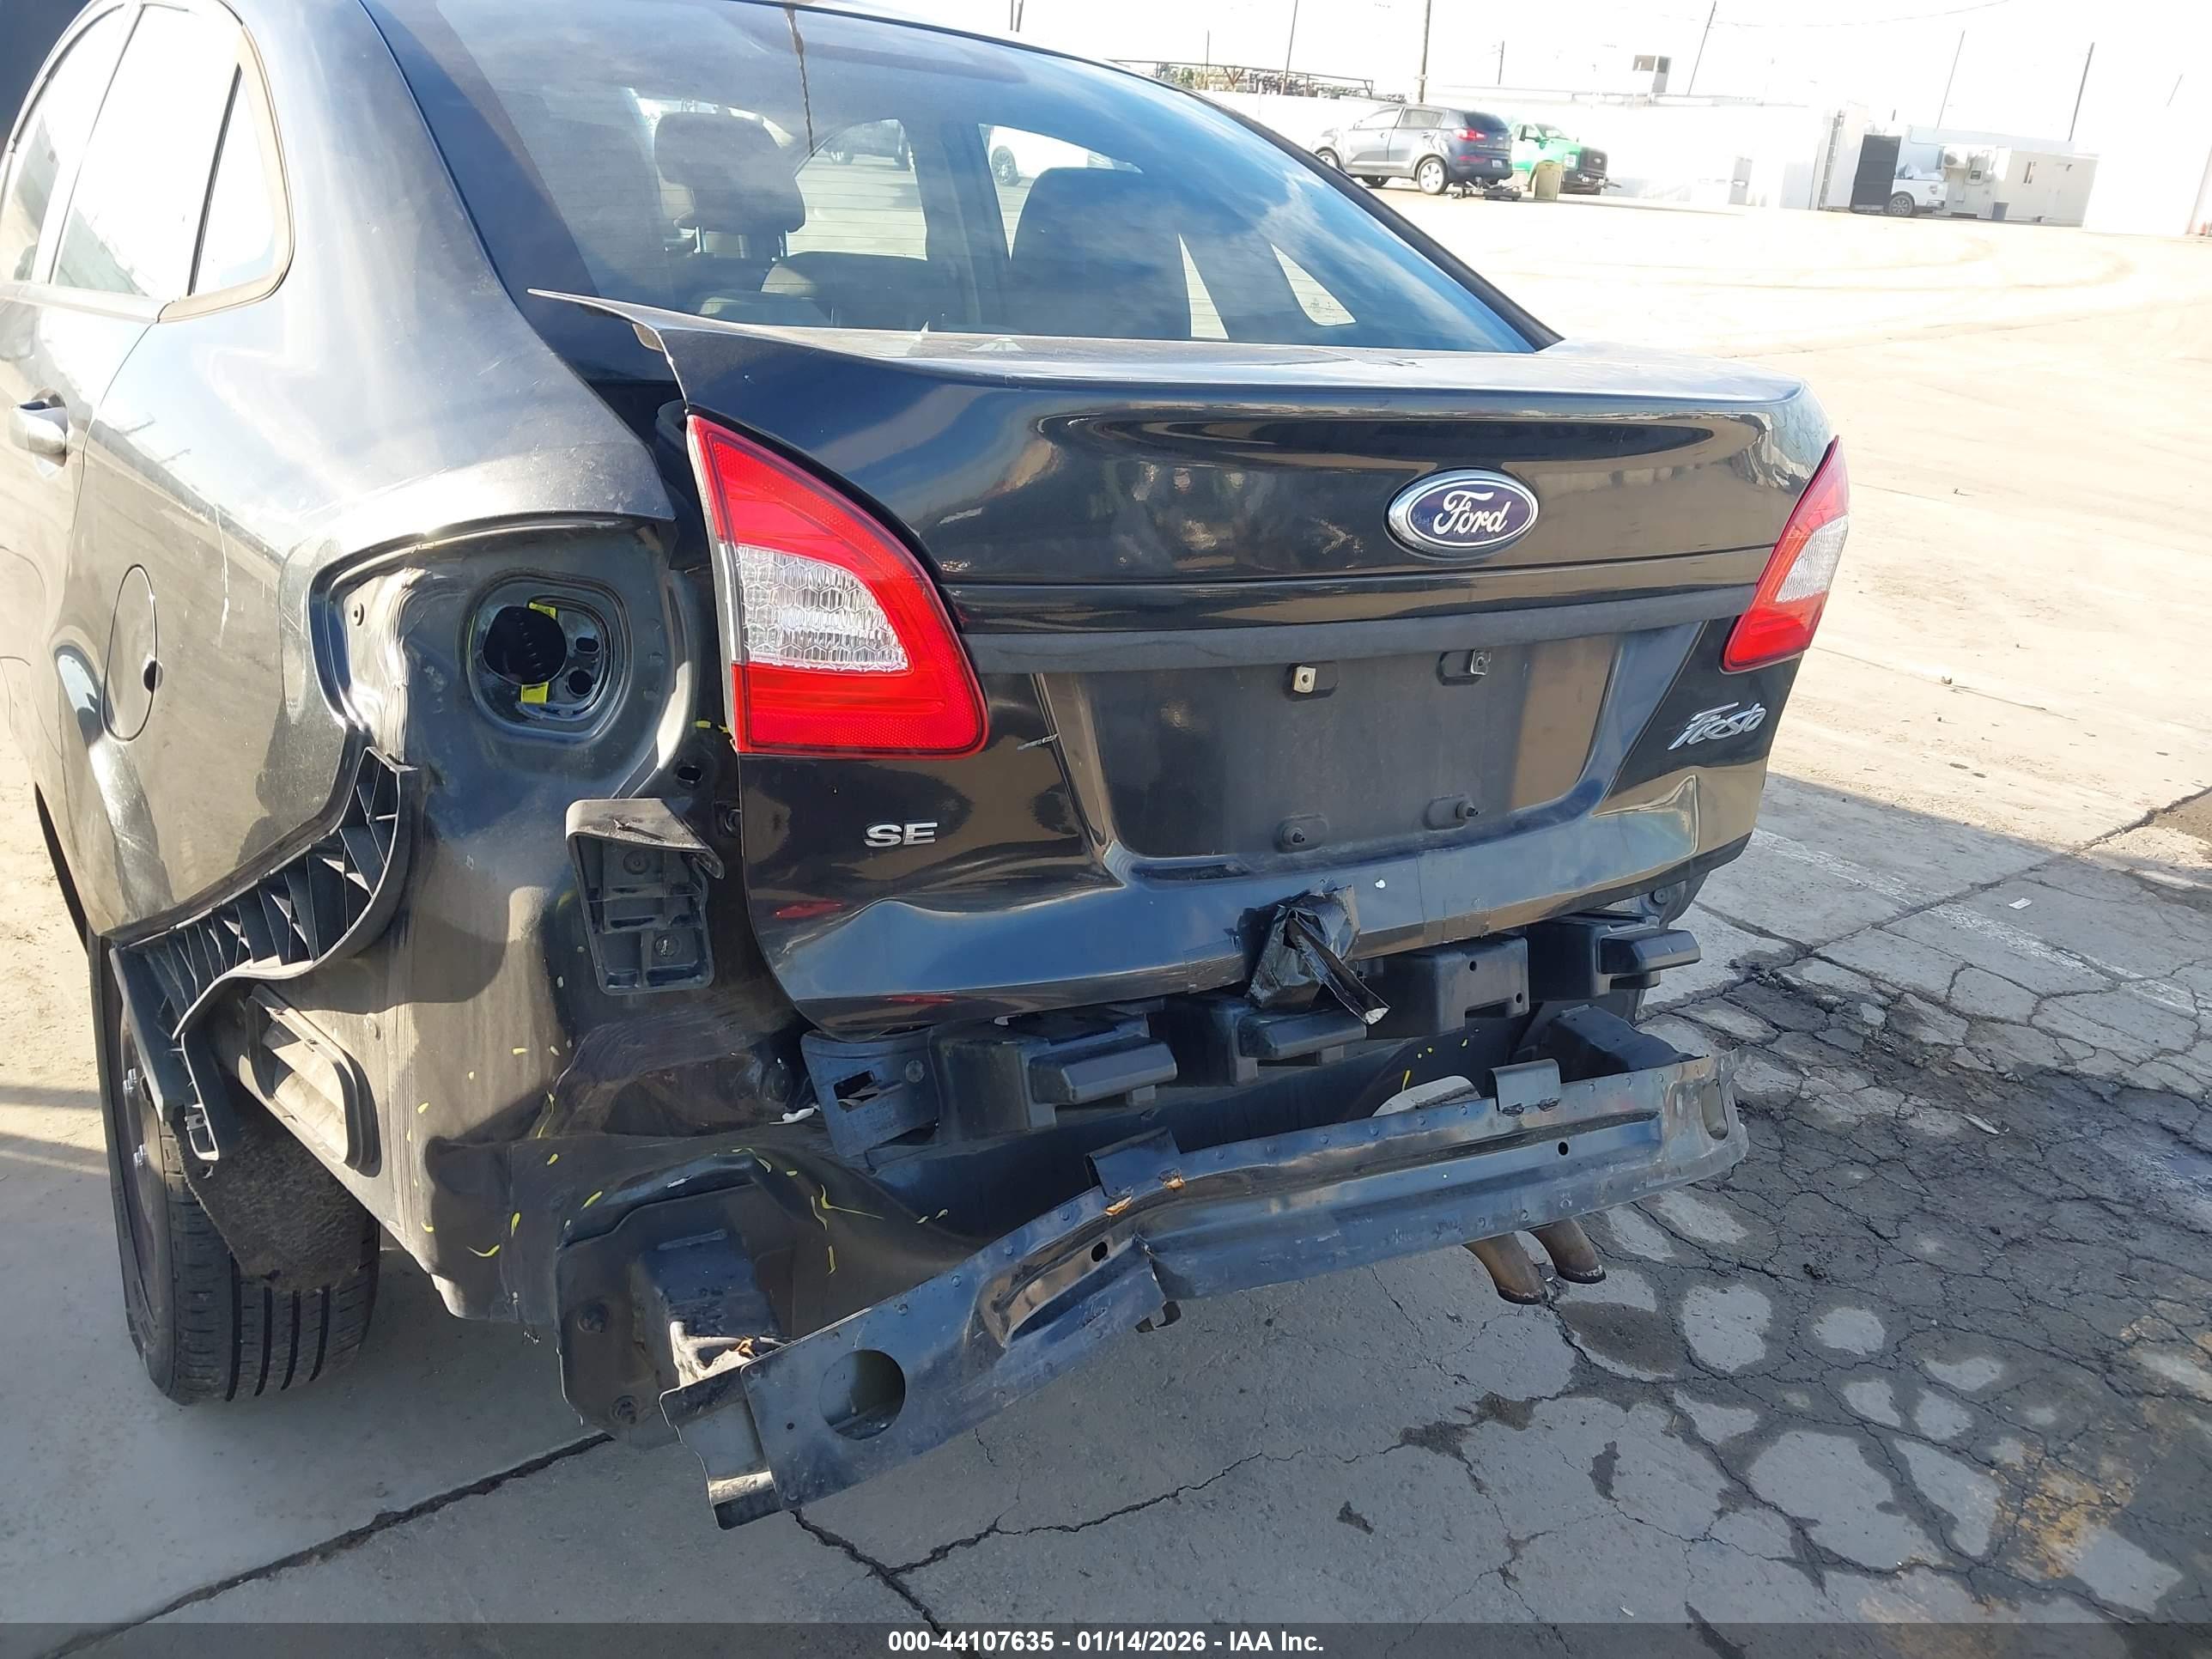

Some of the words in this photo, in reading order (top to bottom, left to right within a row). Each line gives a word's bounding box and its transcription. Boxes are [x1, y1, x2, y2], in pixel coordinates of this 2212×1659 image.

[1433, 489, 1511, 535] Ford
[1667, 701, 1767, 750] Fiesta
[865, 822, 938, 848] SE
